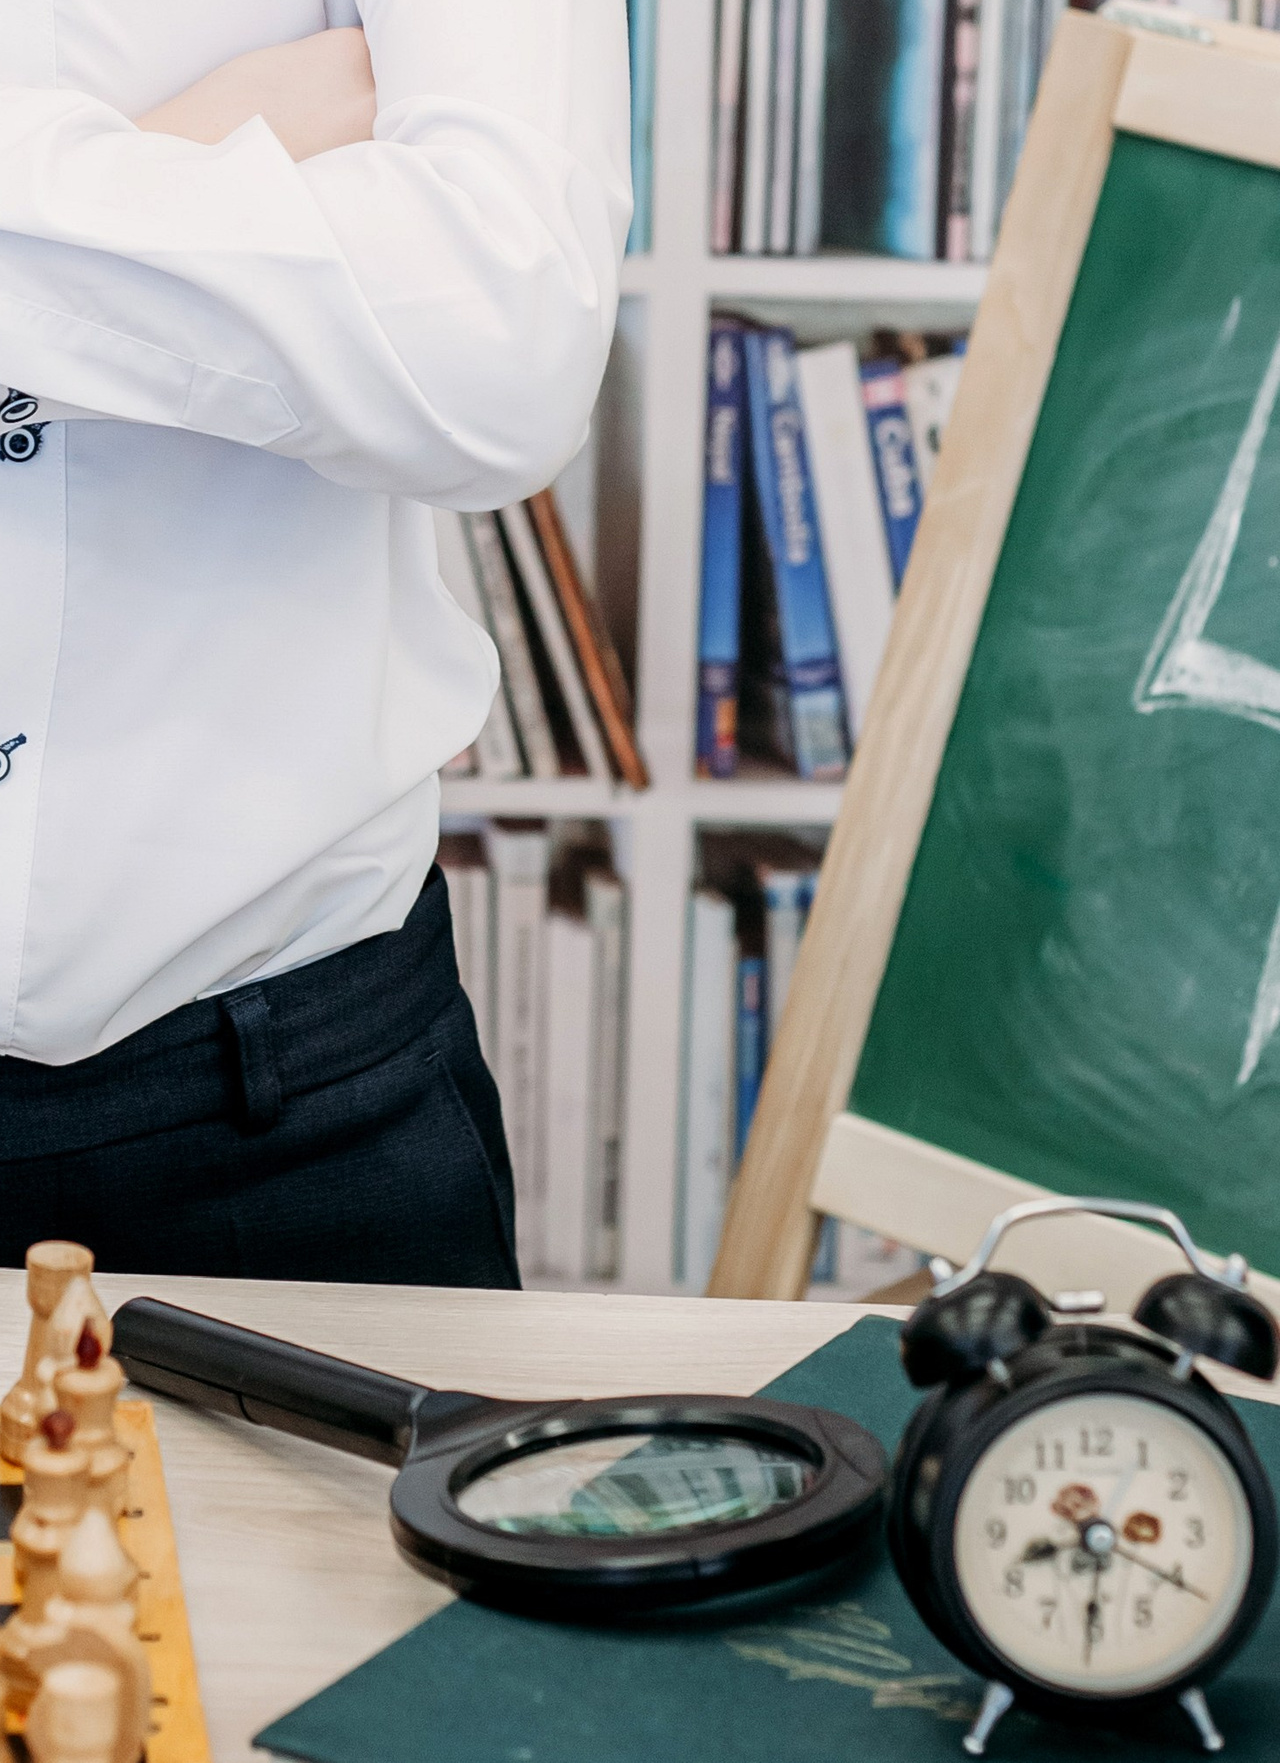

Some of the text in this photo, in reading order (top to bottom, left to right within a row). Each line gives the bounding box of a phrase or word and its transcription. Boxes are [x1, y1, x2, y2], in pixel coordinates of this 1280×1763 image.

[1035, 1438, 1065, 1470] 11
[1079, 1426, 1114, 1456] 12
[1004, 1473, 1037, 1506] 10
[1168, 1467, 1189, 1501] 2
[985, 1515, 1008, 1549] 9
[1185, 1515, 1206, 1550] 3
[1039, 1596, 1058, 1630] 7
[1132, 1592, 1154, 1629] 5
